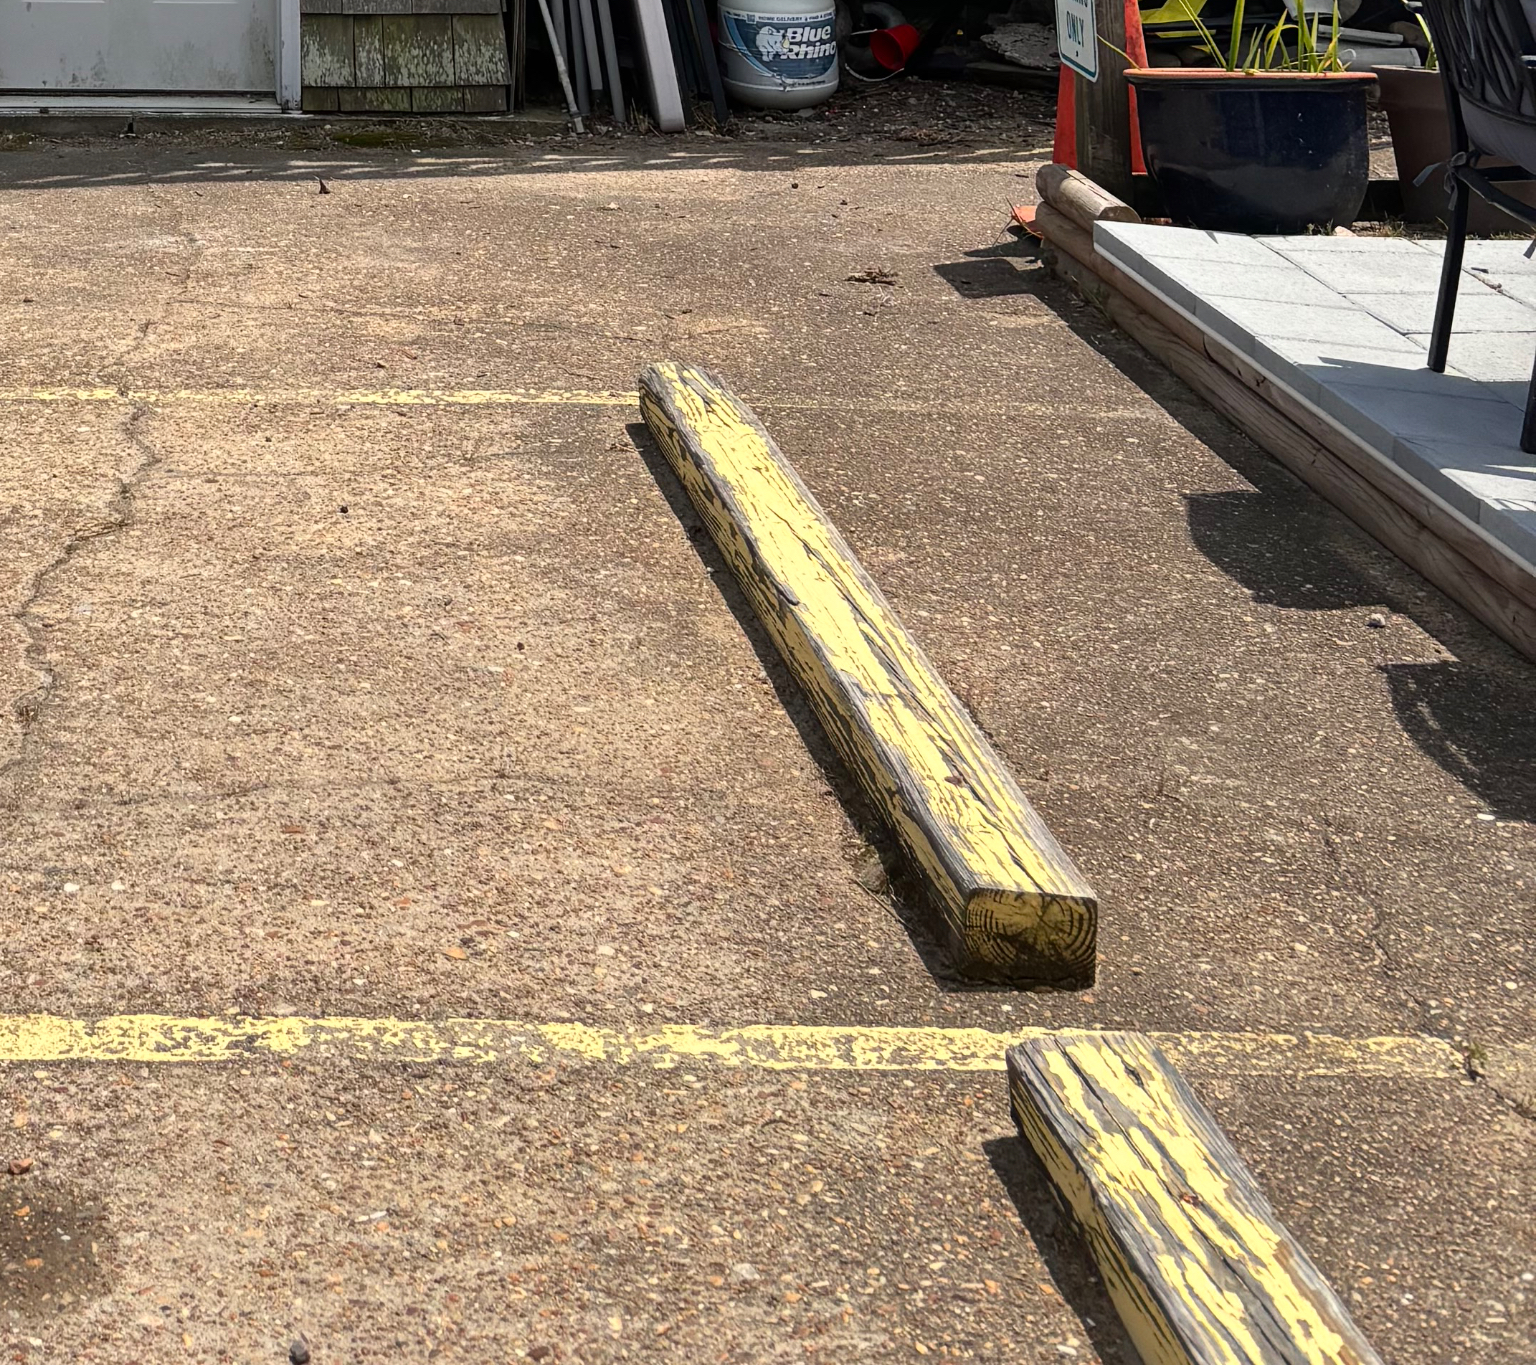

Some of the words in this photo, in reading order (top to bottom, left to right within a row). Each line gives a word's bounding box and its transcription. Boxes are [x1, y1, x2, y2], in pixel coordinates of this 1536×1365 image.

[786, 25, 831, 42] Blue
[1066, 10, 1085, 48] ONLY
[780, 41, 836, 59] Rhino
